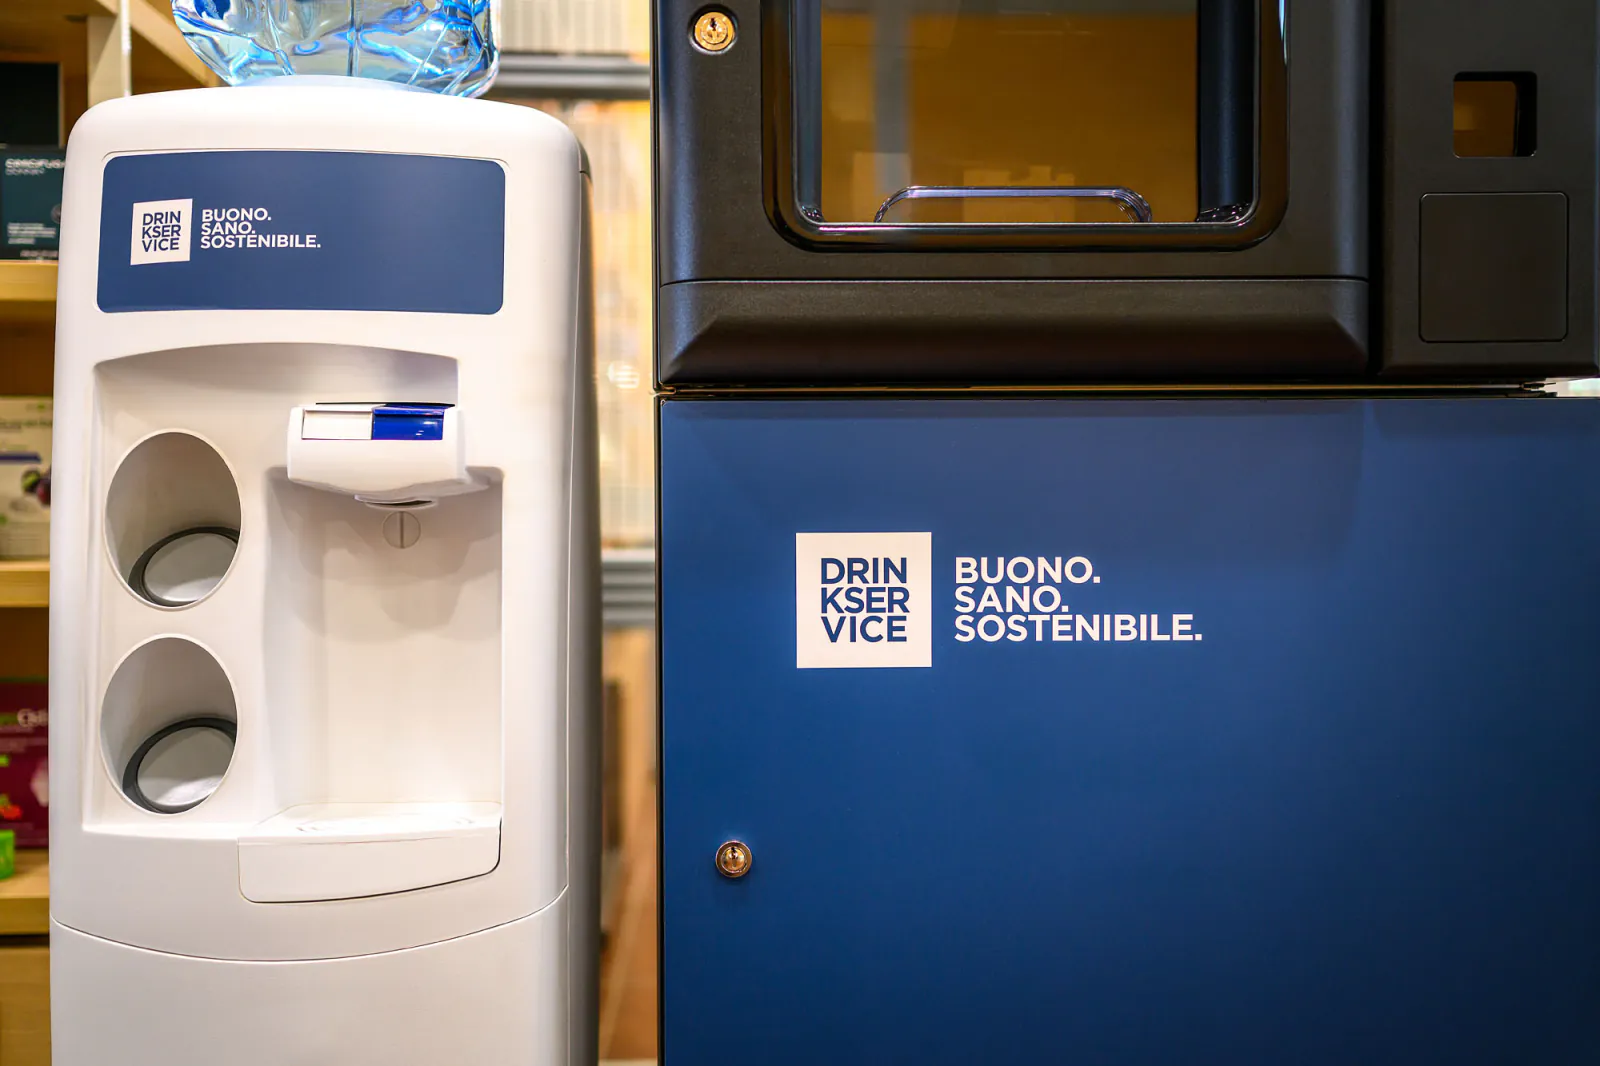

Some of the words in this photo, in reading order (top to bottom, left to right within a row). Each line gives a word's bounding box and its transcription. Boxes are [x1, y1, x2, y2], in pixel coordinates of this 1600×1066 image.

[142, 210, 181, 226] DRIN
[201, 207, 272, 223] BUONO.
[142, 224, 182, 239] KSER
[200, 221, 256, 236] SANO.
[142, 237, 180, 253] VICE
[200, 234, 322, 249] SOSTENIBILE.
[820, 557, 908, 585] DRIN
[954, 556, 1102, 584] BUONO.
[820, 586, 911, 614] KSER
[953, 585, 1069, 613] SANO.
[820, 615, 908, 643] VICE
[953, 614, 1203, 642] SOSTENIBILE.
